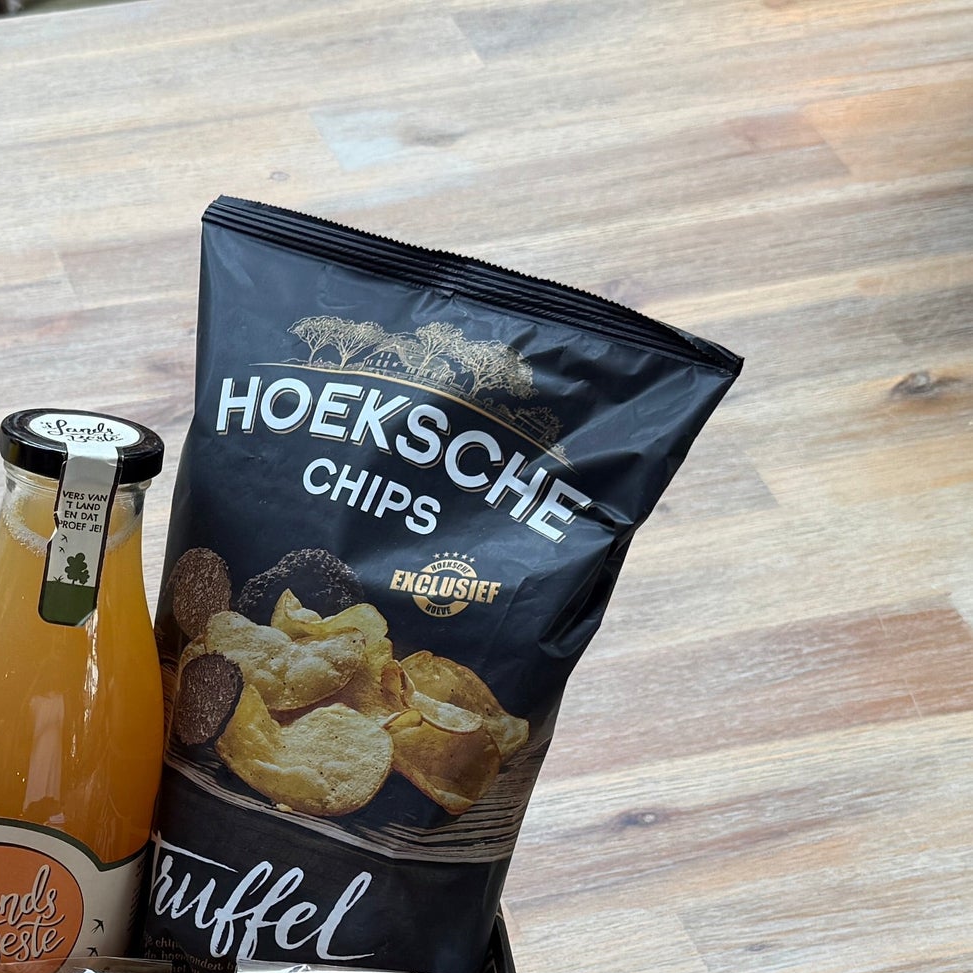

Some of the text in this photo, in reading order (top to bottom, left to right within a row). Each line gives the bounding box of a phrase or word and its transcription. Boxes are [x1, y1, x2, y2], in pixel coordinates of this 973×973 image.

[215, 375, 593, 543] HOEKSCHE
[62, 490, 108, 502] VERS VAN
[303, 457, 442, 536] CHIPS
[76, 501, 101, 511] LAND
[64, 510, 99, 522] EN DAT
[89, 524, 103, 533] JE!
[389, 569, 503, 604] EXCLUSIEF
[425, 603, 452, 616] HOEVE
